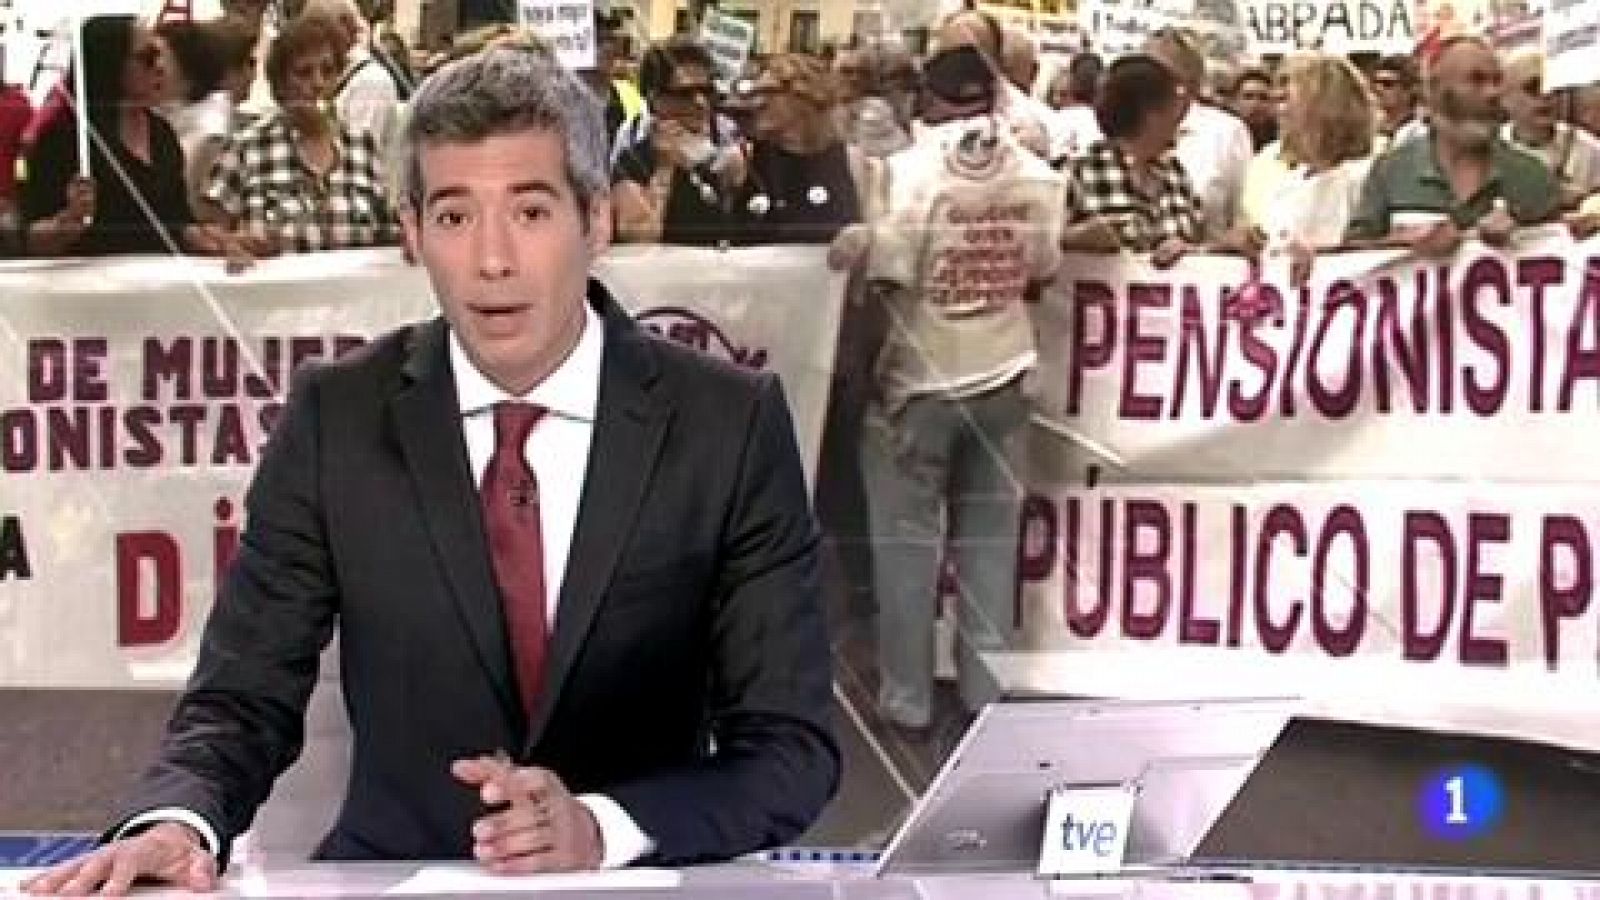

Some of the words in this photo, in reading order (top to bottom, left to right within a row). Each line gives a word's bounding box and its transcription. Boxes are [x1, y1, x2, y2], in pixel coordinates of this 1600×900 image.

[27, 339, 108, 402] DE
[1066, 256, 1600, 421] PENSIONISTA
[1013, 466, 1370, 657] PÚBLICO
[1403, 510, 1511, 667] DE
[1060, 813, 1118, 858] tve
